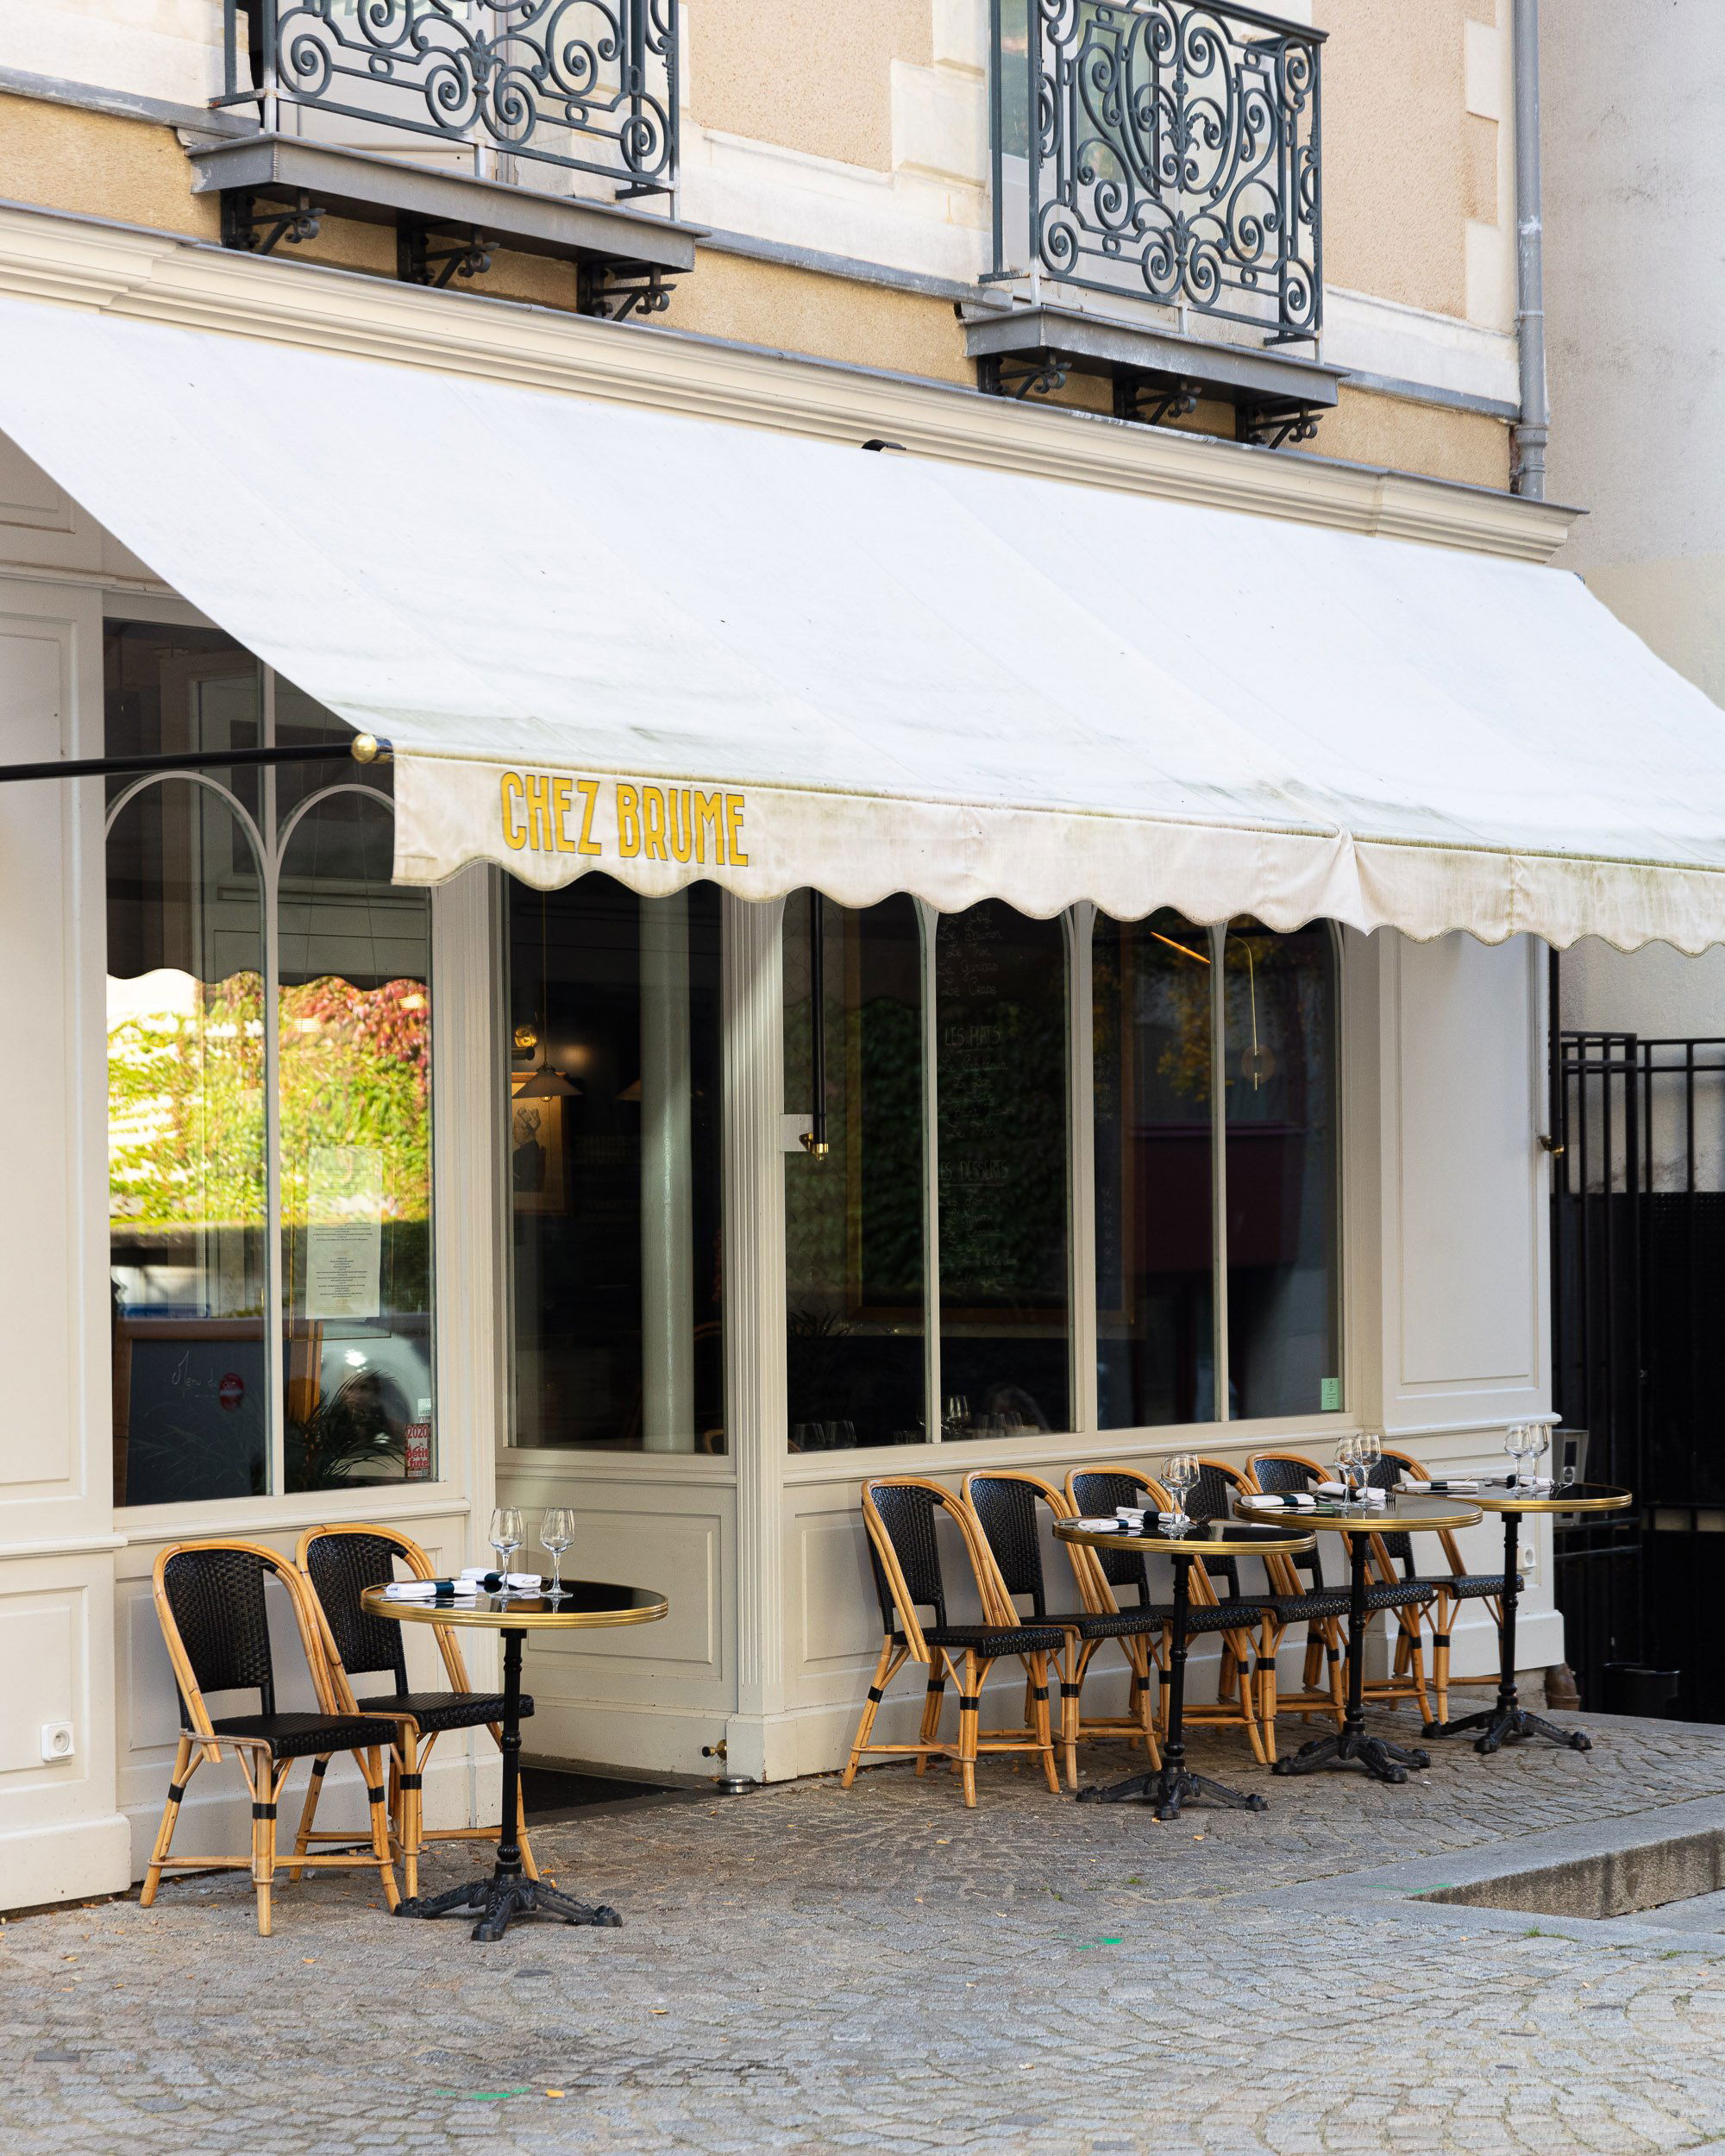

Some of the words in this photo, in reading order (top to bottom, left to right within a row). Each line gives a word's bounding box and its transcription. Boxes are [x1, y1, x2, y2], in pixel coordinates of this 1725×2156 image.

[500, 771, 602, 856] CHEZ
[616, 783, 749, 868] BRUME
[944, 1026, 965, 1047] LES
[969, 1025, 1001, 1046] PLATS
[959, 1159, 1008, 1181] DESSERTS
[172, 1350, 201, 1398] Menu
[406, 1426, 429, 1438] 2020
